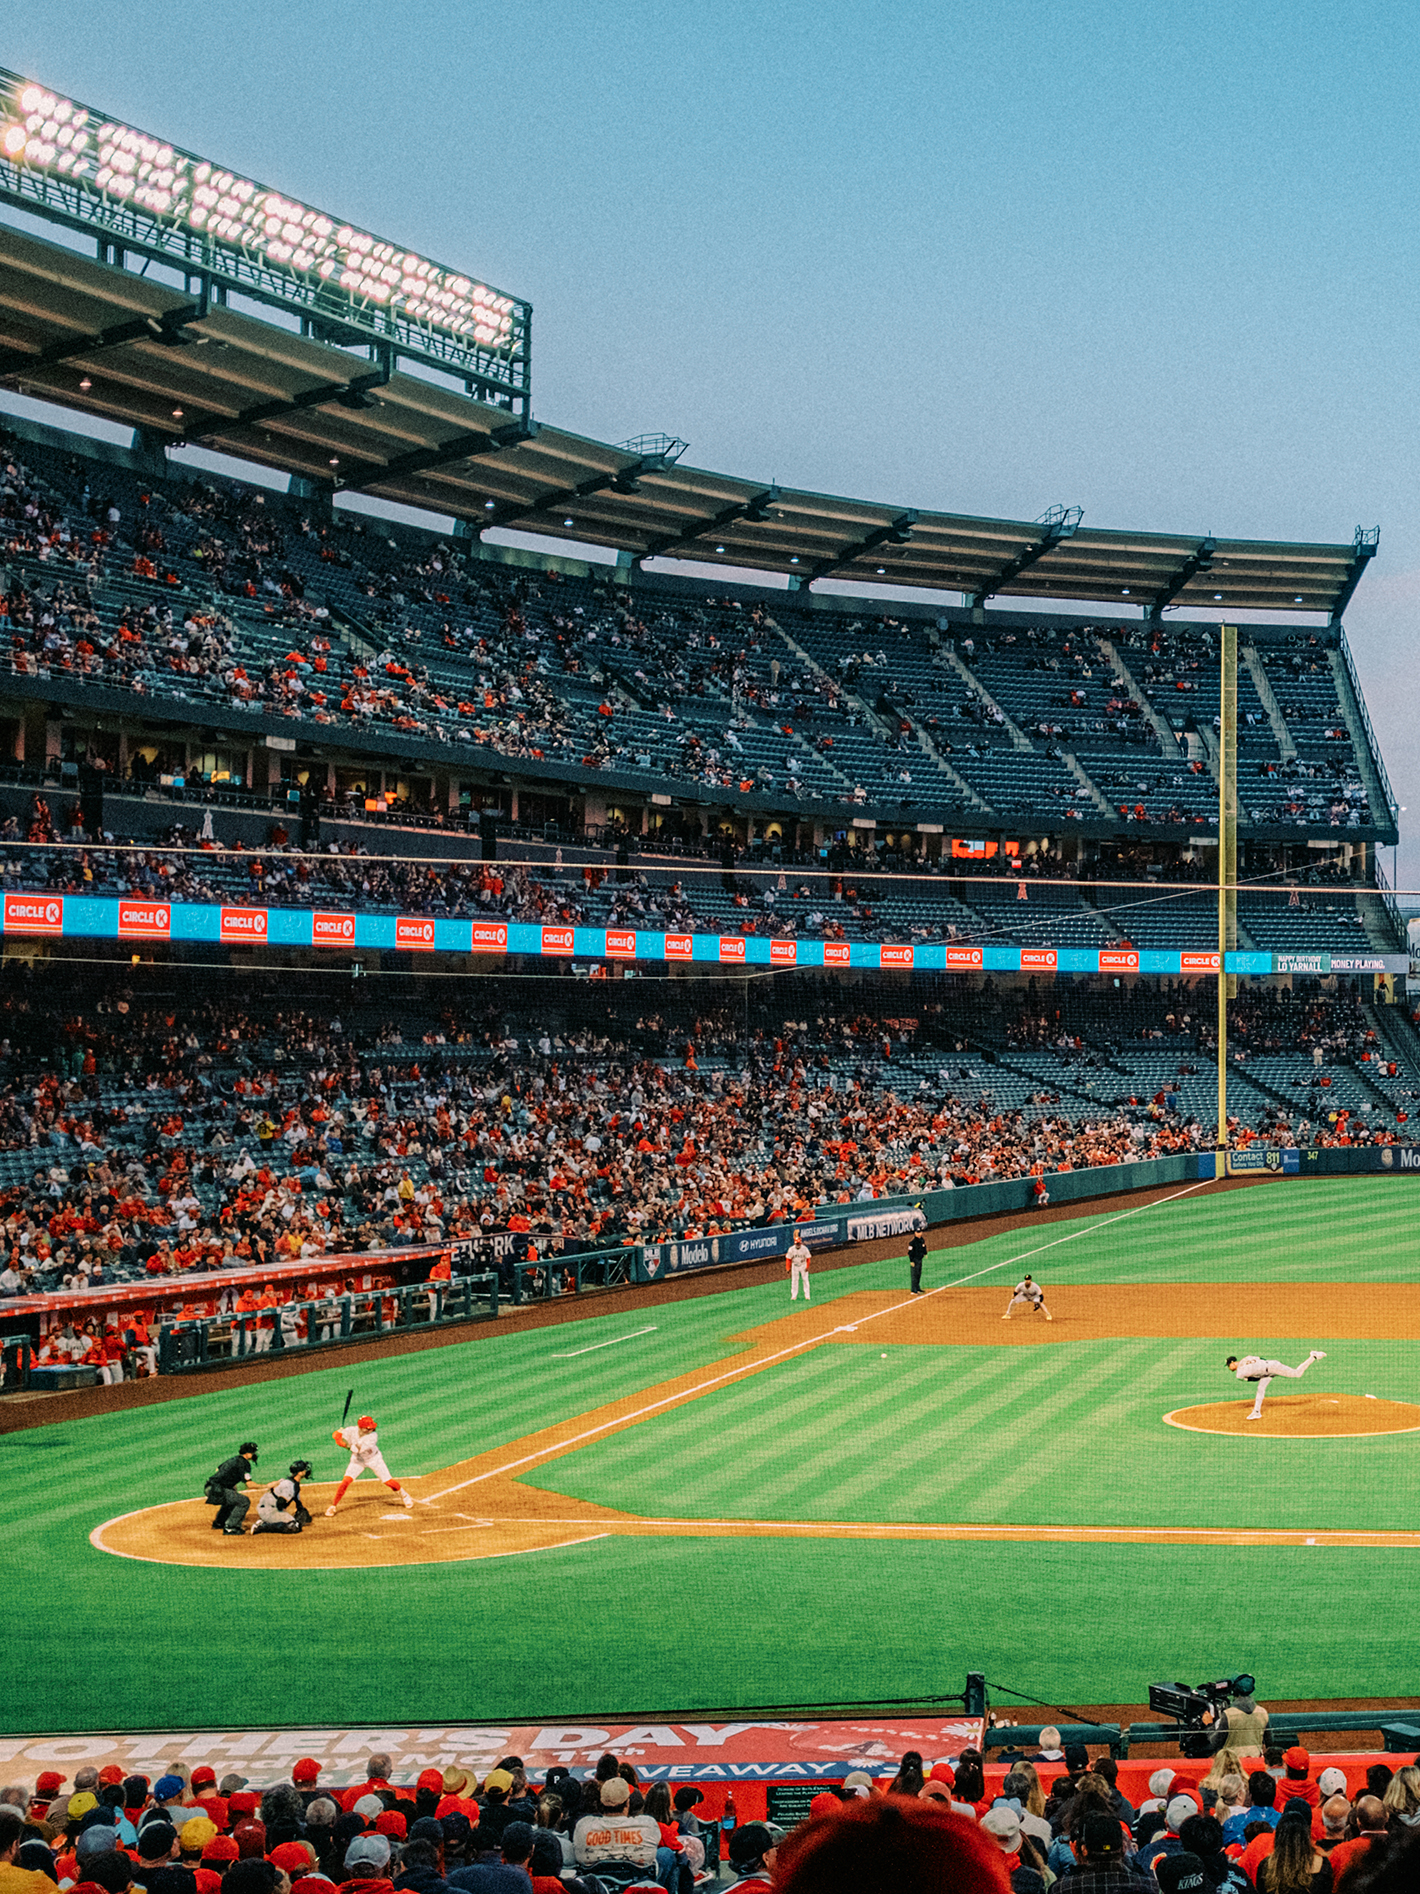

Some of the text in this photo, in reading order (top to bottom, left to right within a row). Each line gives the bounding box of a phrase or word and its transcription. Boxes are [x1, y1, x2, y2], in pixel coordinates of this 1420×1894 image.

[8, 903, 60, 923] CIRCLE K
[122, 909, 168, 928] CIRCLE K
[224, 914, 265, 933] CIRCLE K
[315, 920, 353, 937] CIRCLE K
[399, 924, 433, 941] CIRCLE K
[474, 928, 506, 944] CIRCLE K
[543, 932, 573, 947] CIRCLE K
[607, 935, 635, 950] CIRCLE K
[882, 949, 912, 962] CIRCLE K
[948, 951, 981, 964] CIRCLE K
[1023, 952, 1055, 965] CIRCLE K
[1102, 954, 1137, 966] CIRCLE K
[1183, 955, 1220, 967] CIRCLE K
[1331, 959, 1354, 969] MONEY
[1232, 1152, 1264, 1162] Contact
[1266, 1151, 1280, 1164] 811
[1307, 1151, 1319, 1160] 347
[857, 1224, 875, 1241] MLB
[750, 1236, 778, 1250] HYUNDAI
[681, 1241, 709, 1266] Modelo
[530, 1723, 757, 1750] DAY
[586, 1829, 643, 1846] GOOD TIMES
